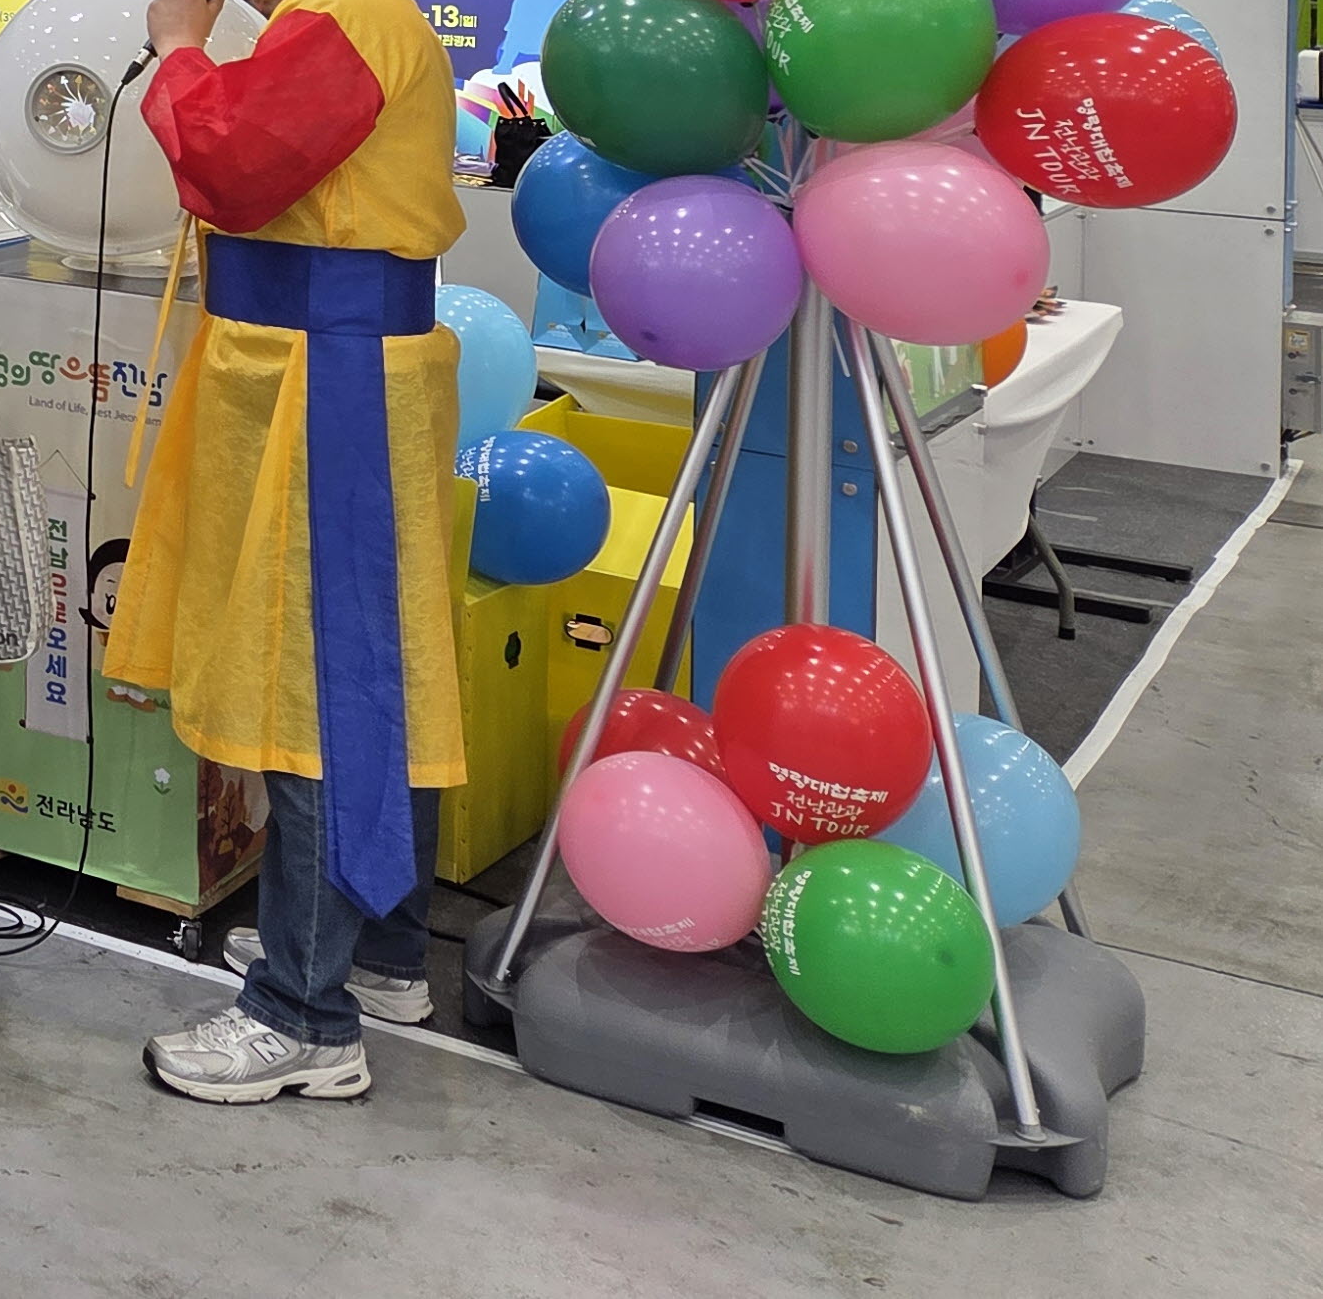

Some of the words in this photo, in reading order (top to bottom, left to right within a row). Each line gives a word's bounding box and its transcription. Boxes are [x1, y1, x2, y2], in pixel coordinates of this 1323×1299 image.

[1016, 108, 1050, 140] JN
[1034, 146, 1081, 194] TOUR
[1053, 119, 1102, 181] 전남관광
[1076, 98, 1134, 188] 명량대첩축제
[29, 395, 53, 409] Land
[55, 399, 67, 410] of
[68, 402, 89, 416] Life,
[94, 407, 112, 419] est
[768, 761, 889, 803] 명량대첩축제
[36, 792, 117, 834] 전라남도
[770, 801, 804, 826] JN
[809, 817, 870, 836] TOUR
[786, 791, 865, 822] 전남관광
[782, 870, 812, 976] 명량대첩축제
